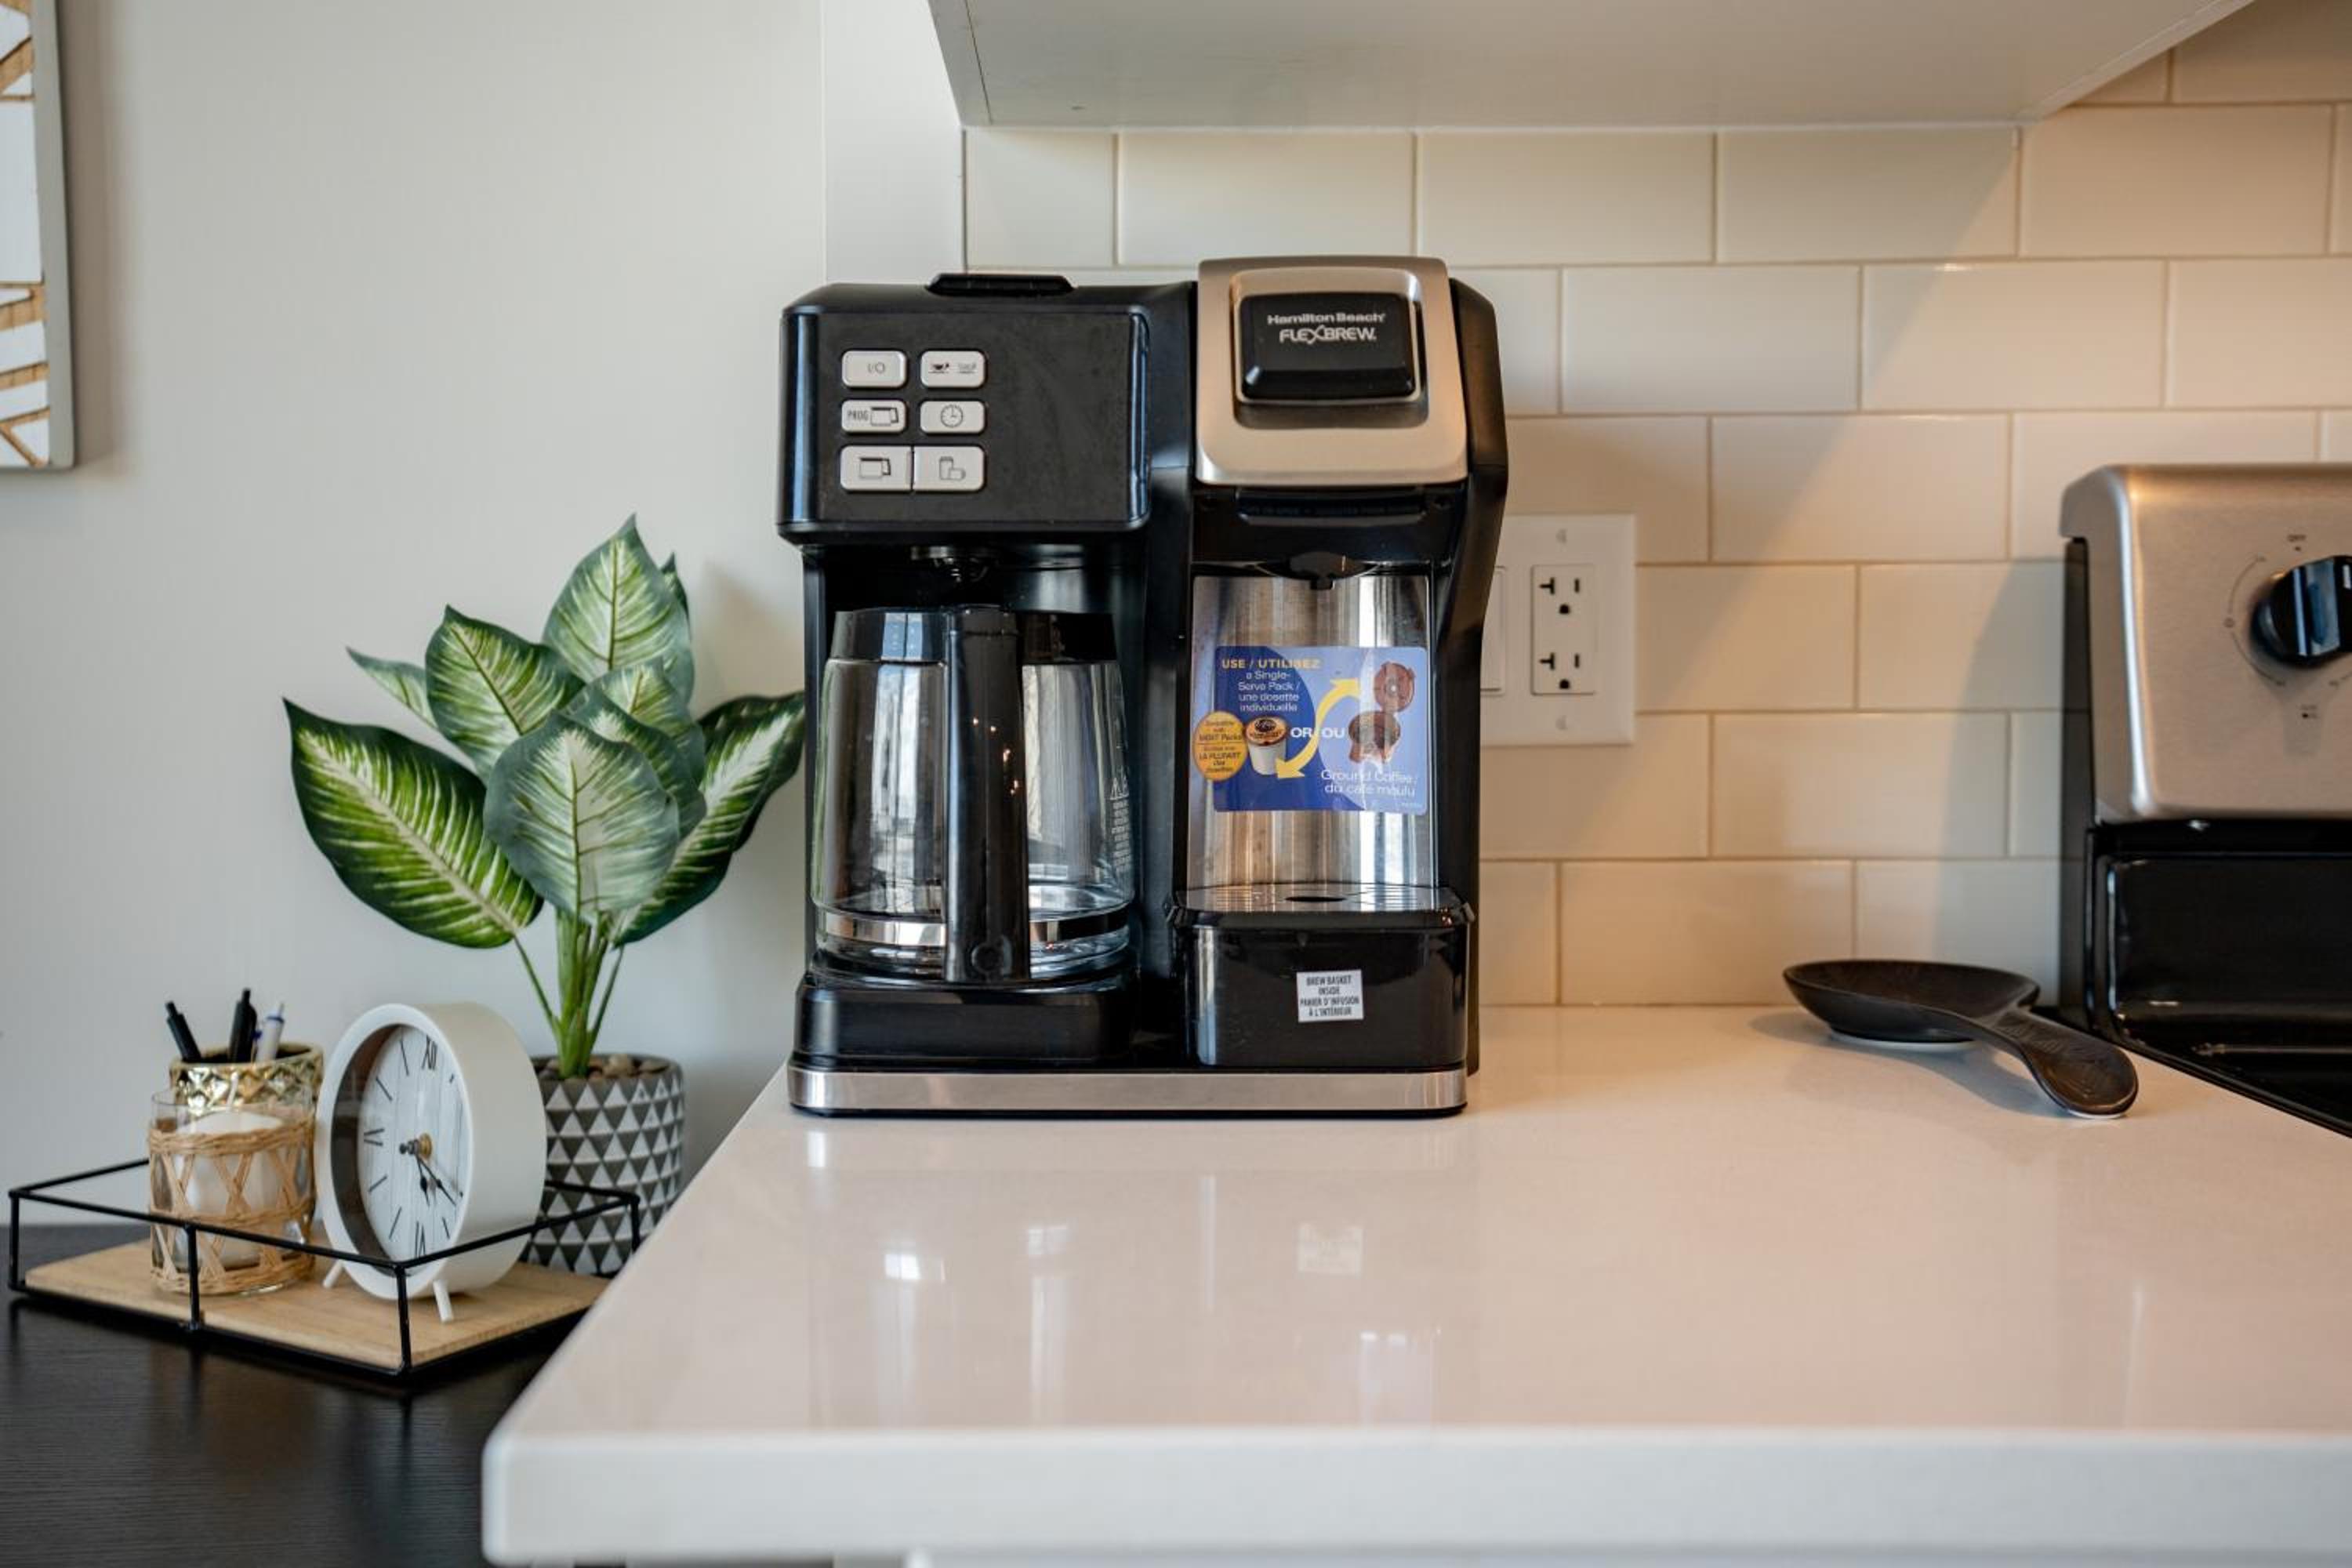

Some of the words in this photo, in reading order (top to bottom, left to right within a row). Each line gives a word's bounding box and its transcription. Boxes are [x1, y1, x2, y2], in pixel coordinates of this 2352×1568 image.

[1267, 314, 1333, 325] Hamilton
[1336, 312, 1385, 323] Beach
[848, 410, 869, 422] PROG
[1222, 659, 1245, 669] USE
[1258, 658, 1321, 669] UTILISEZ
[1239, 681, 1266, 691] Serve
[1268, 681, 1294, 691] Pack
[1290, 727, 1312, 738] OR
[1322, 727, 1345, 738] OU
[1324, 783, 1342, 793] du
[1306, 976, 1326, 986] BREW
[1327, 975, 1352, 985] BASKET
